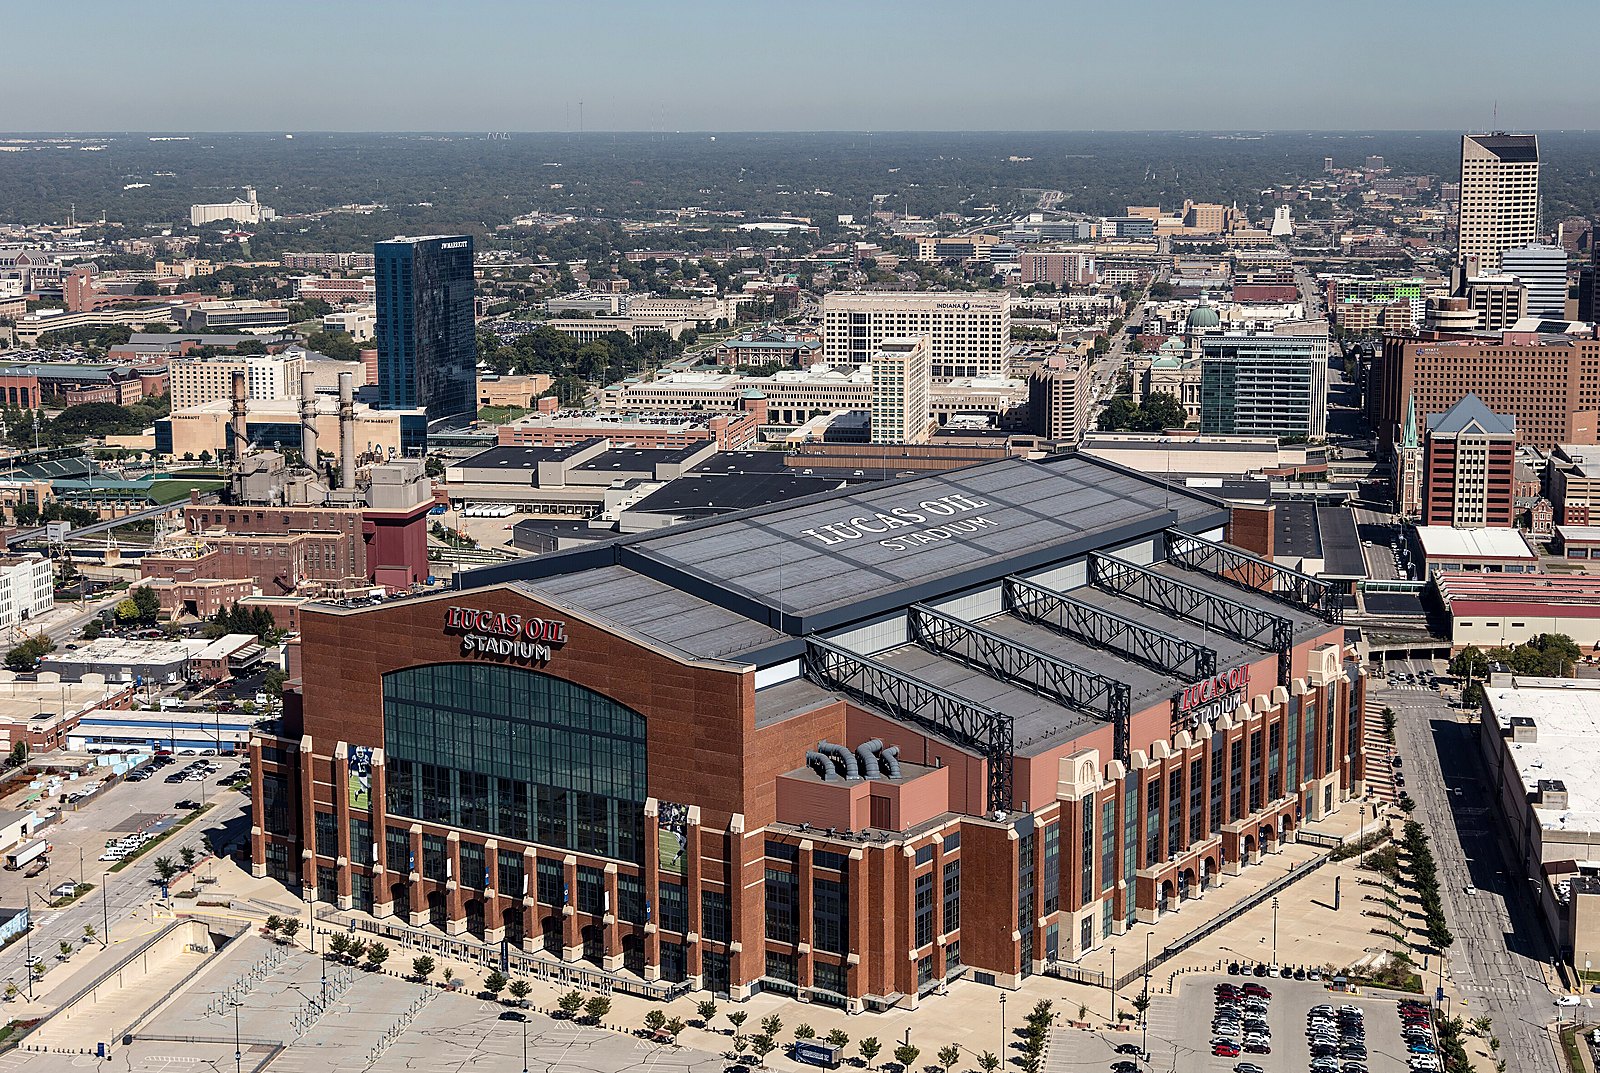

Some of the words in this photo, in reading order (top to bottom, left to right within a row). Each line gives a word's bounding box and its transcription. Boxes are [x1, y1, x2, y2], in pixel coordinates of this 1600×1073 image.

[800, 506, 927, 546] LUCAS
[918, 493, 990, 517] OIL
[879, 516, 999, 551] STADIUM
[446, 606, 522, 637] LUCAS
[525, 617, 568, 642] OIL
[463, 633, 551, 661] STADIUM
[1179, 671, 1227, 711] LUCAS
[1228, 662, 1251, 691] OIL
[1192, 693, 1242, 728] STADIUM
